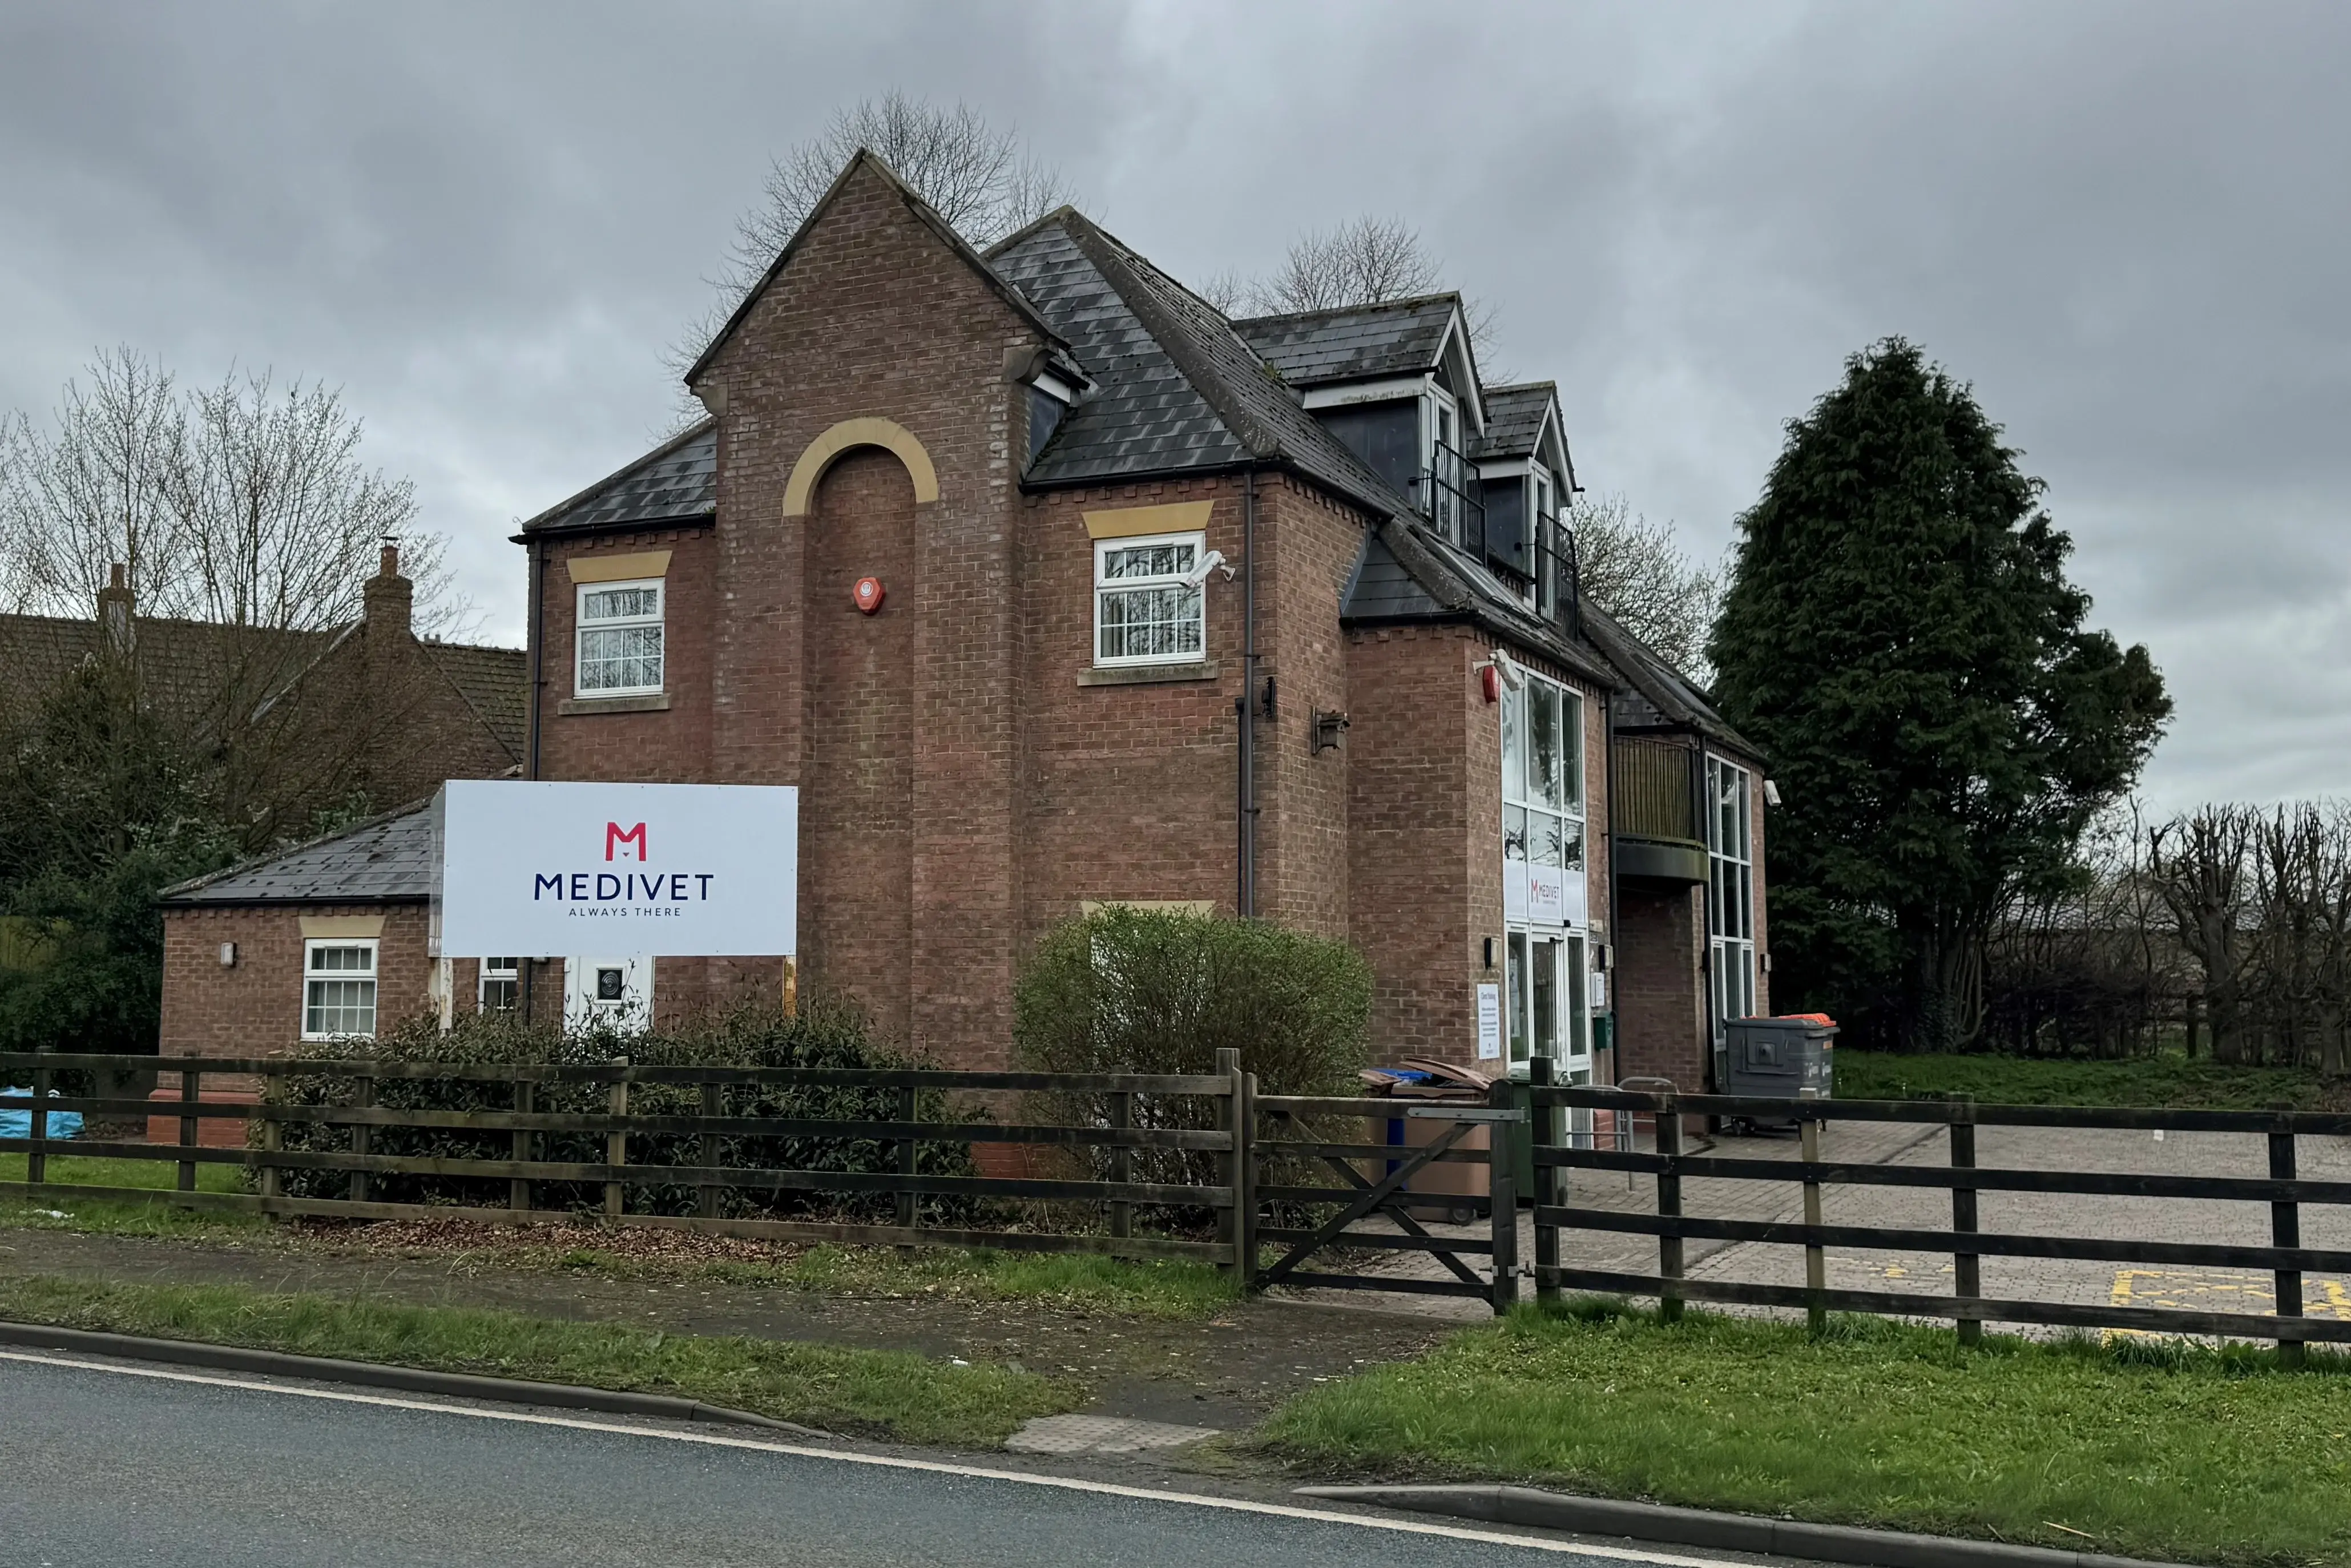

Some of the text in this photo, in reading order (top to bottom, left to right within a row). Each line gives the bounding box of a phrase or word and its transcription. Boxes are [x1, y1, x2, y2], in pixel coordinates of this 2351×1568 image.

[605, 822, 646, 861] M
[534, 873, 714, 900] MEDIVET
[1539, 884, 1559, 899] MEDIVET
[569, 908, 681, 916] ALWAYS THERE
